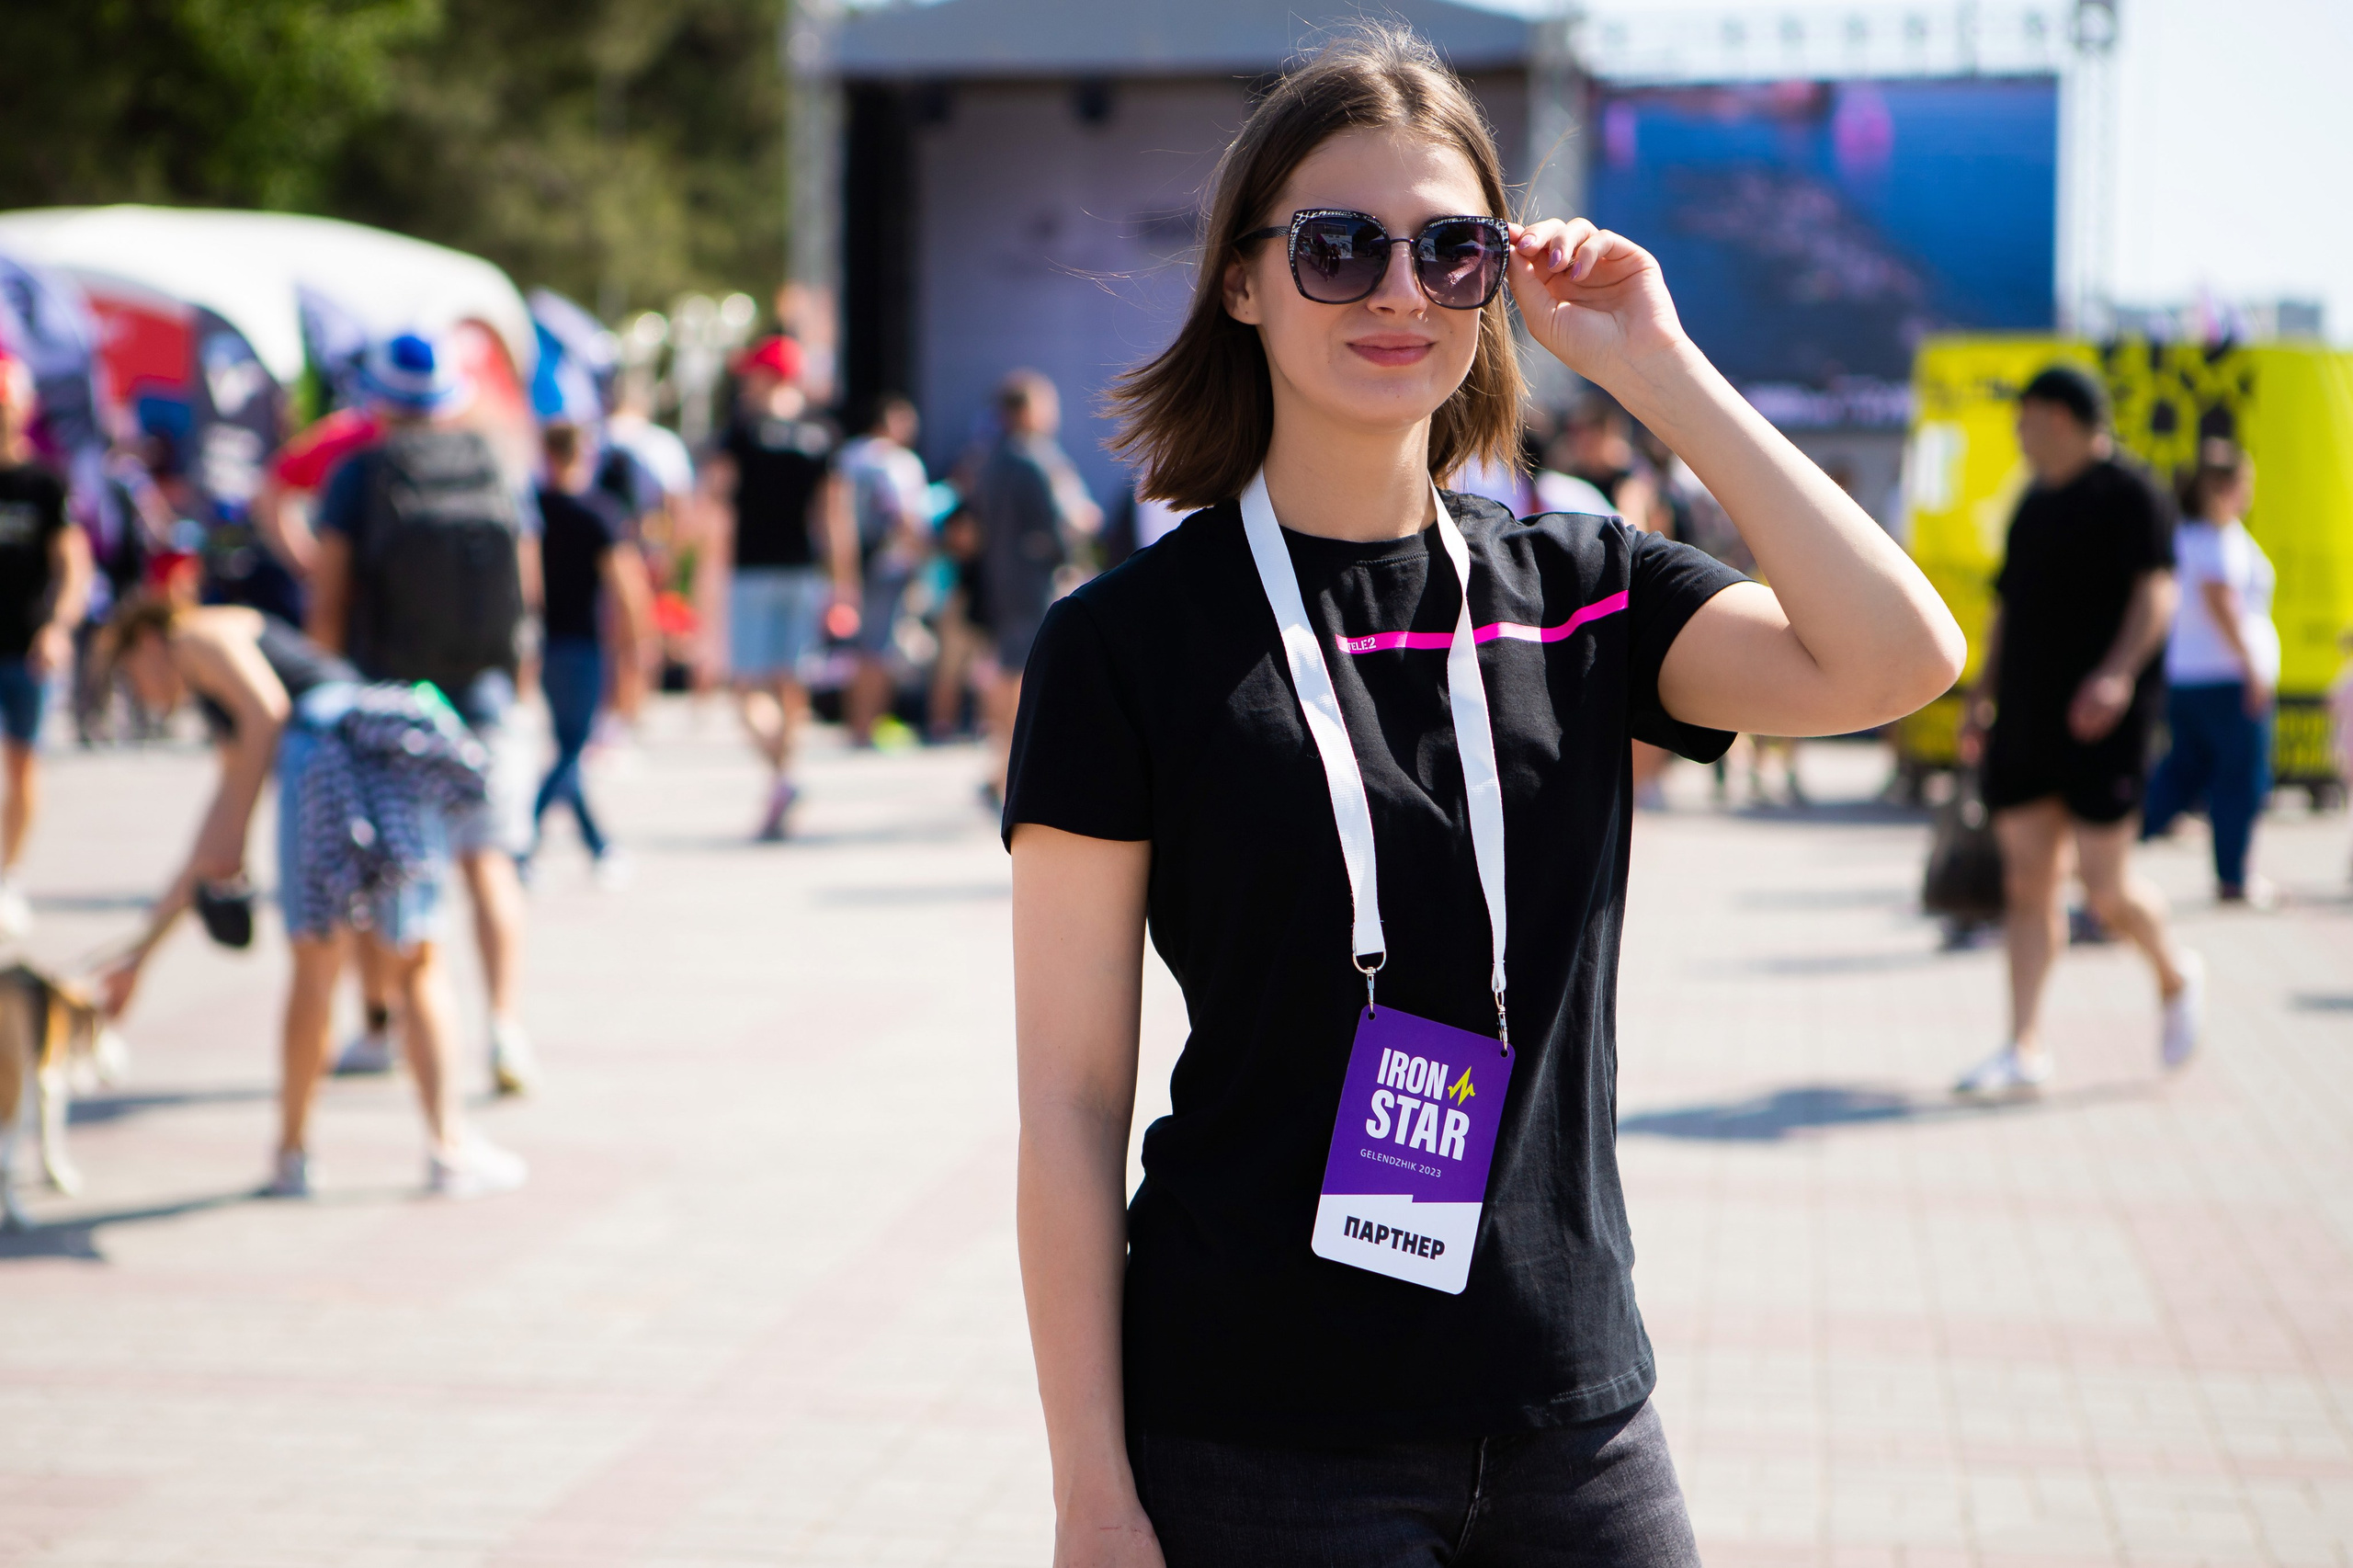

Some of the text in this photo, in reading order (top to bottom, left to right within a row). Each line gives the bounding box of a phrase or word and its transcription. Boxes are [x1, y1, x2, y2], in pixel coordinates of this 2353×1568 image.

[1347, 637, 1377, 651] TELE2
[1377, 1047, 1449, 1101] IRON
[1365, 1089, 1471, 1161] STAR
[1360, 1148, 1442, 1178] GELENDZHIK 2023
[1343, 1215, 1446, 1260] ПАРТНЕР
